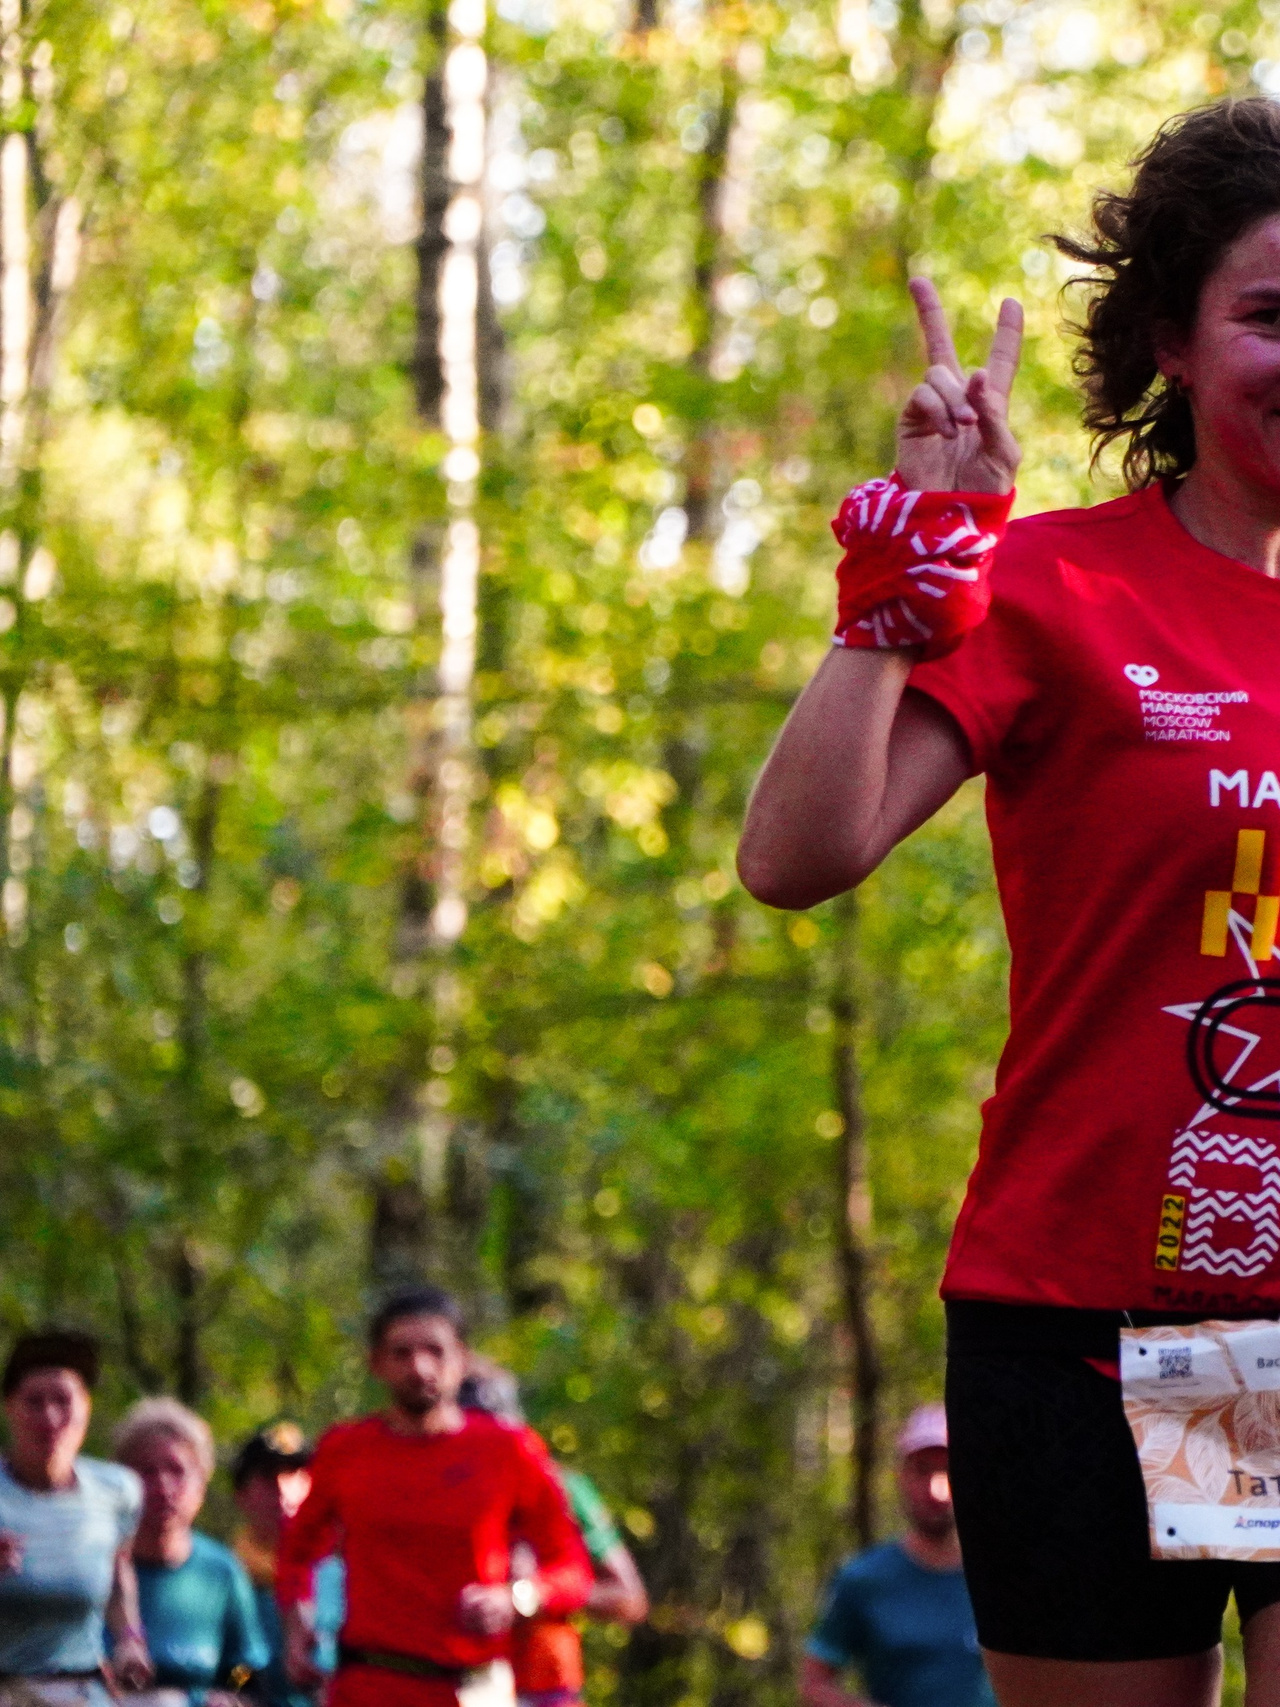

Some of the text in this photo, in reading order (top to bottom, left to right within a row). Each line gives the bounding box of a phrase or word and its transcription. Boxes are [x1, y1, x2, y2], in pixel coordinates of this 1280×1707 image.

[1139, 689, 1249, 704] МОСКОВСКИЙ
[1141, 702, 1221, 716] МАРАФОН
[1143, 715, 1212, 728] MOSCOW
[1145, 729, 1231, 742] MARATHON
[1156, 1197, 1184, 1268] 2022
